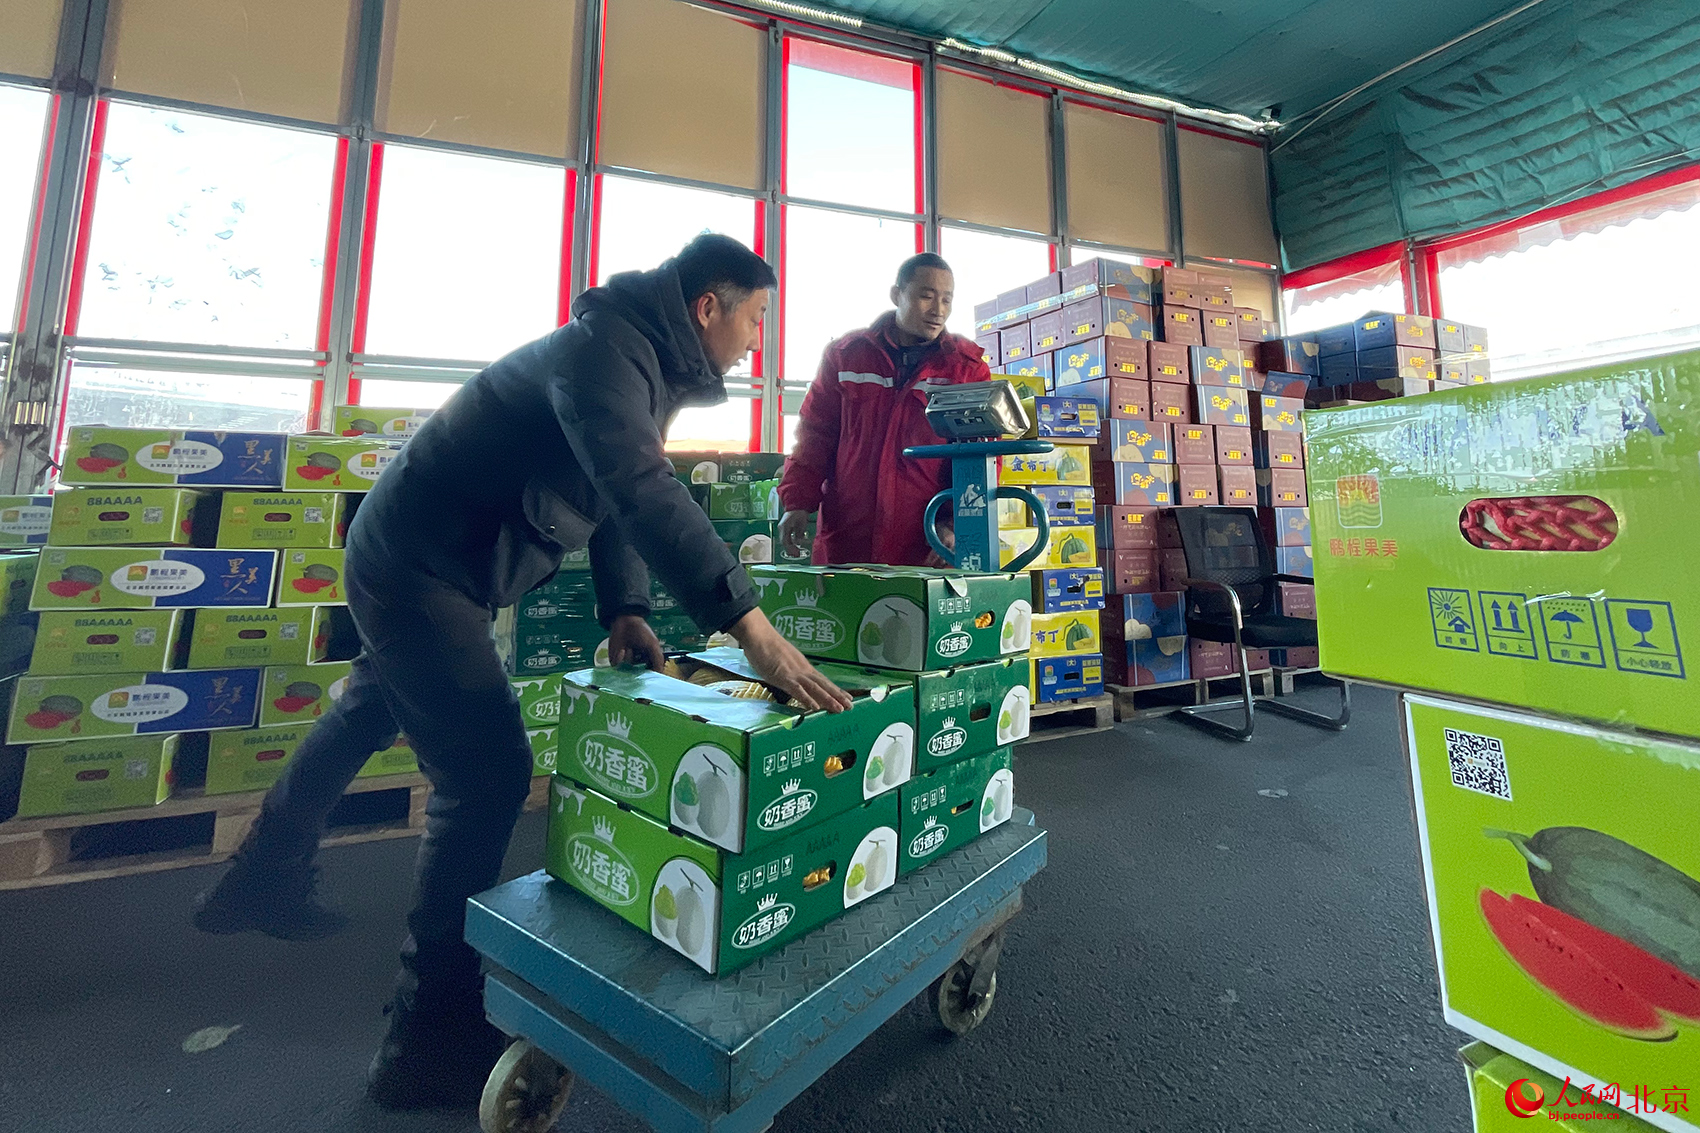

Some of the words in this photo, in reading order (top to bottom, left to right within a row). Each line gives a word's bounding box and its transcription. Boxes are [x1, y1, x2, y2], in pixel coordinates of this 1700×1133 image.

[1011, 456, 1050, 472] 金布丁
[1329, 537, 1399, 558] 鹏程果美
[776, 614, 836, 644] 奶香蜜
[1030, 629, 1059, 645] 布丁
[939, 636, 970, 653] 奶香蜜
[931, 731, 963, 753] 奶香蜜
[584, 739, 649, 792] 奶香蜜
[764, 793, 812, 827] 奶香蜜
[912, 827, 945, 855] 奶香蜜
[573, 840, 631, 899] 奶香蜜
[739, 906, 789, 945] 奶香蜜
